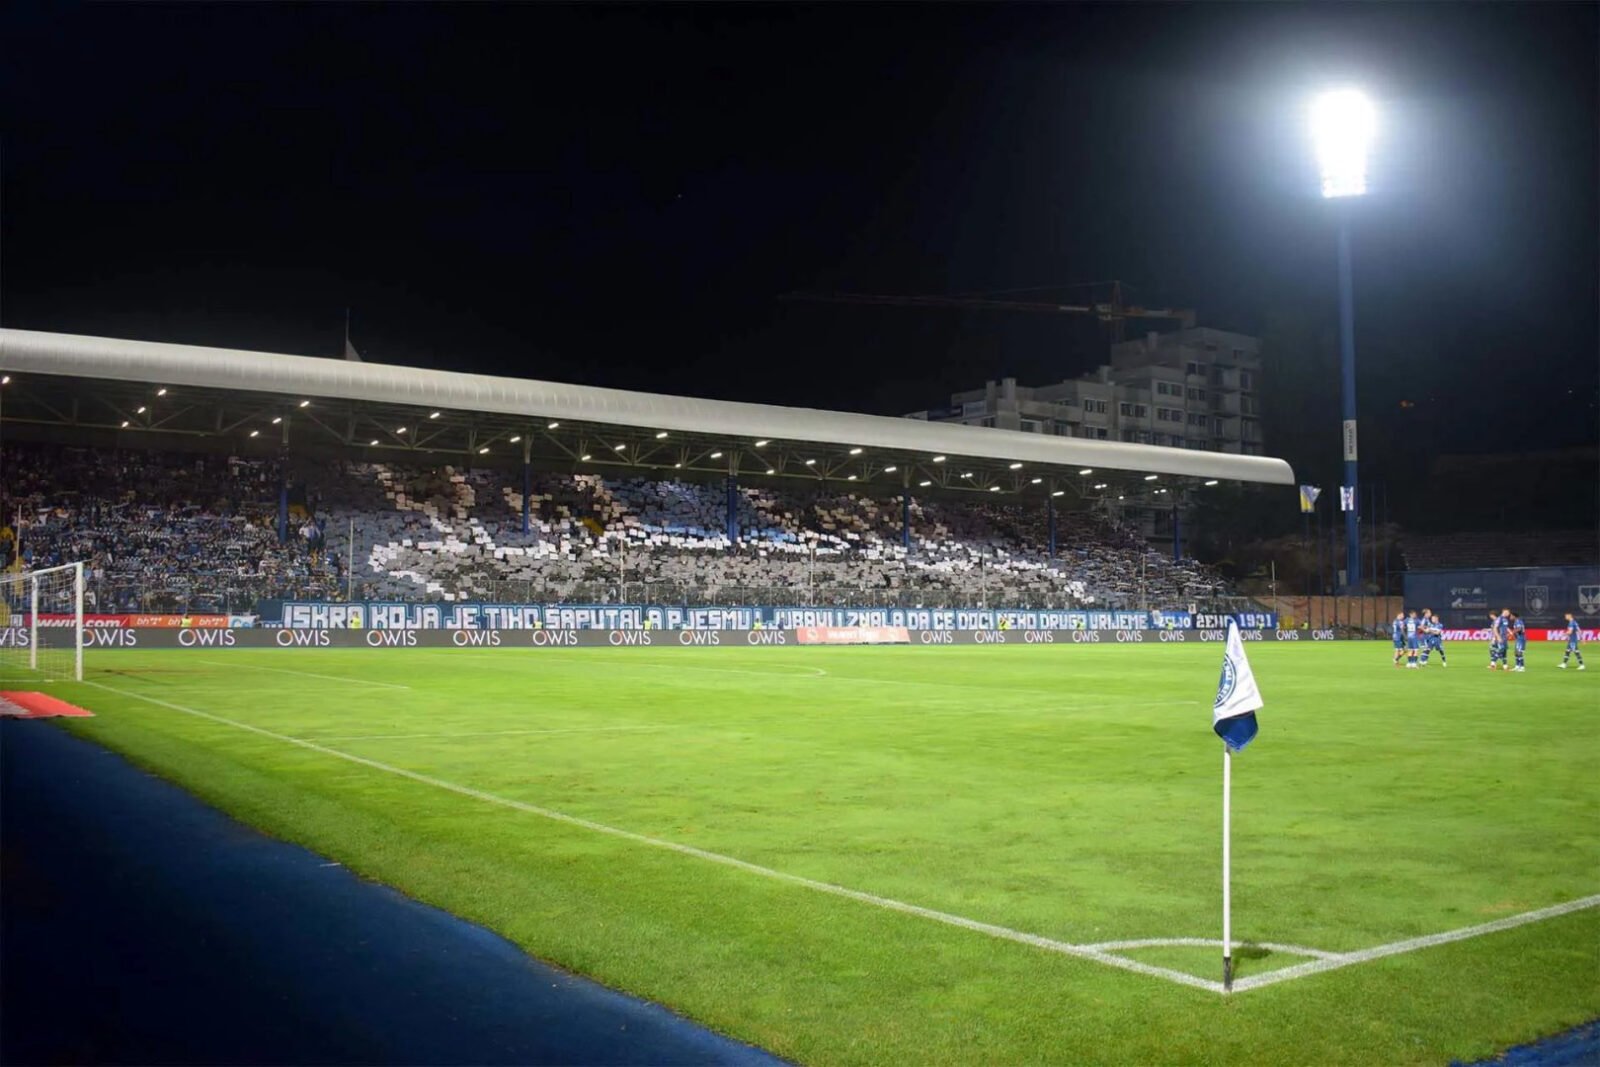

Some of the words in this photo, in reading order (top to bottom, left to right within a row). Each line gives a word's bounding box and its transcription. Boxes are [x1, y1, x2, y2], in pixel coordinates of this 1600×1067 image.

[371, 606, 439, 629] KOJA
[446, 608, 478, 629] JE
[668, 610, 749, 630] PJESMU
[907, 612, 929, 630] DA
[0, 628, 29, 646] IS
[82, 628, 137, 646] OWIS
[178, 628, 235, 646] OWIS
[277, 629, 330, 646] OWIS
[367, 630, 417, 646] OWIS
[453, 630, 500, 646] OWIS
[533, 630, 578, 645] OWIS
[609, 630, 651, 645] OWIS
[680, 630, 720, 645] OWIS
[748, 630, 785, 645] OWIS
[921, 630, 953, 643] OWIS
[975, 630, 1005, 643] OWIS
[1024, 630, 1053, 643] OWIS
[1072, 630, 1099, 643] OWIS
[1116, 630, 1143, 642] OWIS
[1159, 630, 1185, 641] OWIS
[1200, 630, 1224, 641] OWIS
[1240, 630, 1263, 641] OWIS
[1276, 630, 1299, 640] OWIS
[1312, 630, 1334, 640] OWIS
